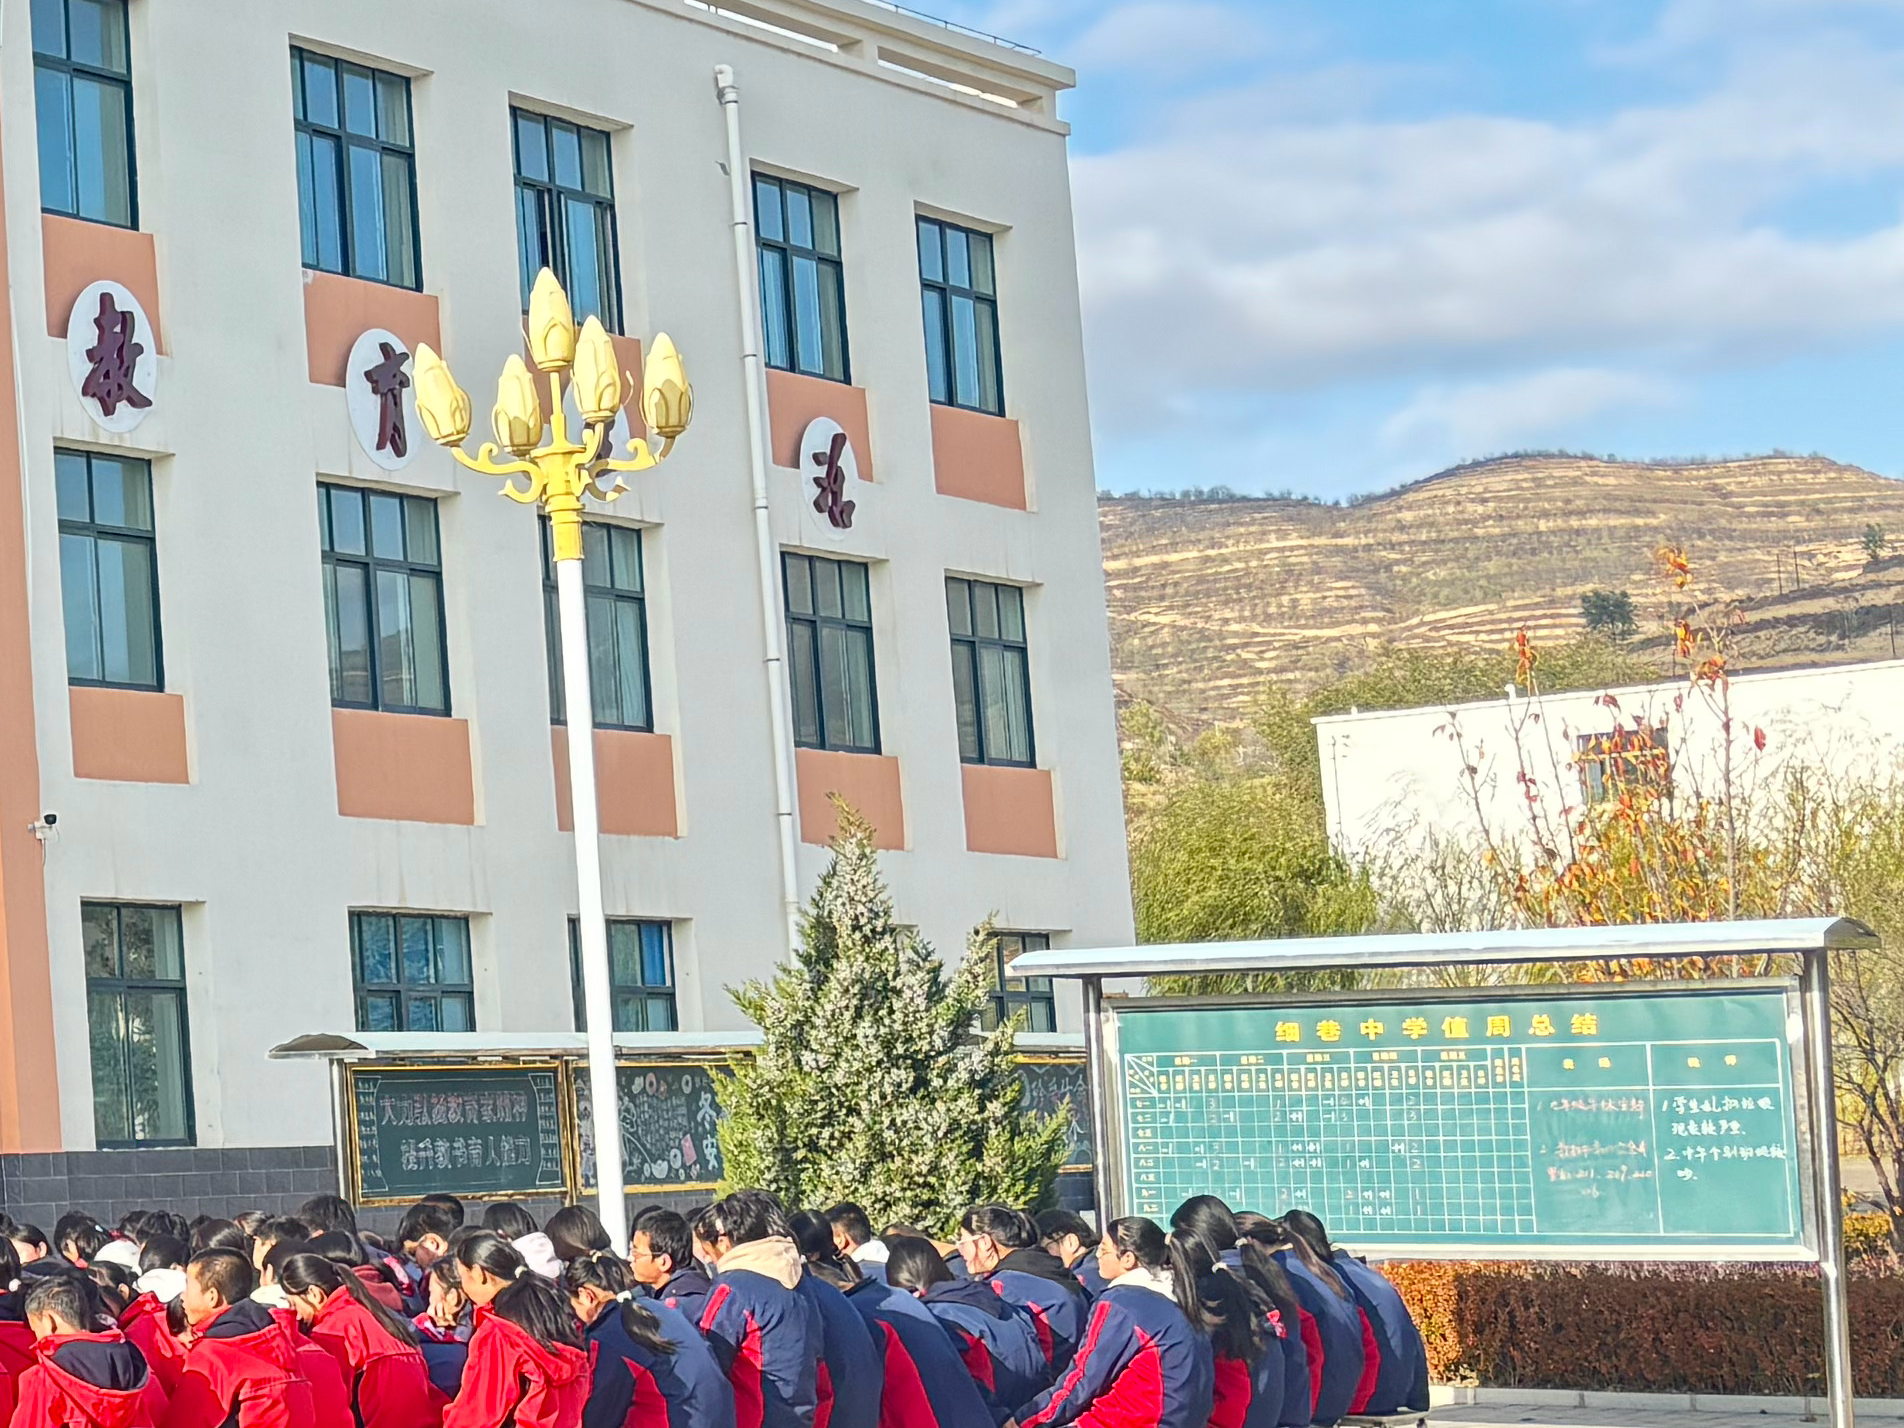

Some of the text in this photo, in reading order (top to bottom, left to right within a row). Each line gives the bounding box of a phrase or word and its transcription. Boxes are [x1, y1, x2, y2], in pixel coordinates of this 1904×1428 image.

[1274, 1012, 1599, 1043] 细巷中学值周总结
